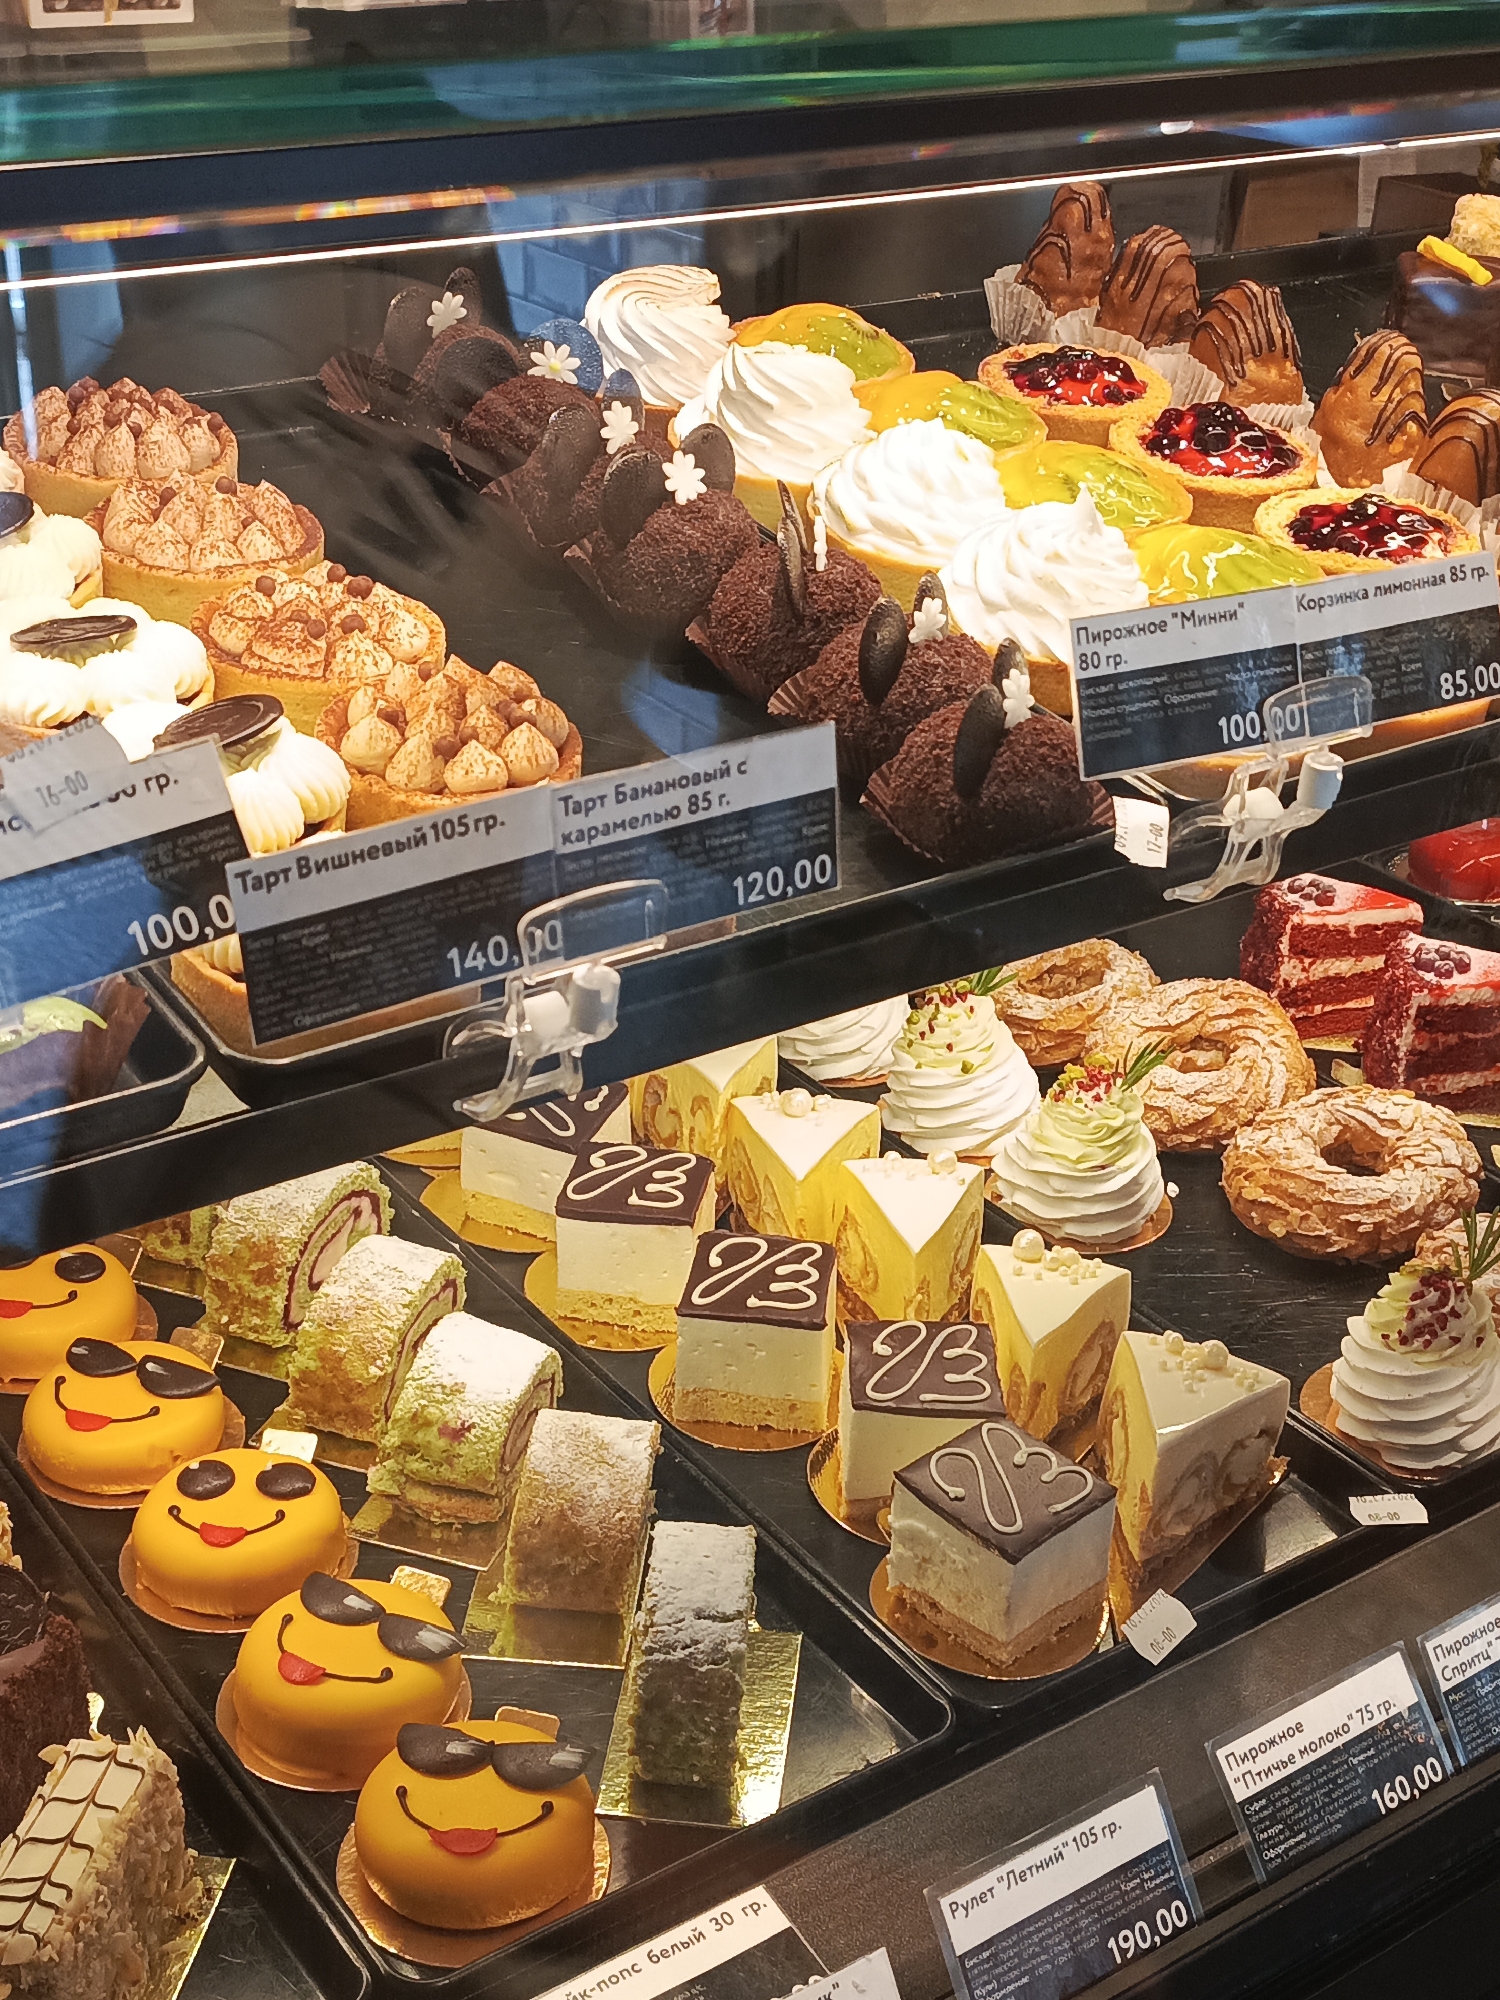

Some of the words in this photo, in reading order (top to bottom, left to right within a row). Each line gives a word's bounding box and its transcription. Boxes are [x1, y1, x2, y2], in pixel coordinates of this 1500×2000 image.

[1296, 587, 1369, 613] Корзинка
[1373, 573, 1446, 597] лимонная
[1450, 564, 1467, 583] 85
[1471, 565, 1490, 582] гр.
[1076, 619, 1168, 646] Пирожное
[1171, 602, 1245, 629] "Минни"
[1079, 652, 1101, 672] 80
[1106, 653, 1128, 671] гр.
[1440, 662, 1500, 700] 85,00
[145, 773, 179, 795] гр.
[558, 791, 607, 817] Тарт
[615, 760, 731, 804] Банановый
[737, 759, 748, 775] с
[561, 806, 681, 846] карамелью
[688, 791, 712, 815] 85
[719, 793, 731, 807] г.
[234, 866, 292, 894] Тарт
[296, 827, 428, 879] Вишневый
[431, 814, 470, 843] 105
[473, 813, 505, 837] гр.
[733, 854, 832, 905] 120,00
[1433, 1617, 1500, 1662] Пирожное
[1441, 1641, 1492, 1682] Спритц"
[1224, 1720, 1304, 1772] Пирожное
[1234, 1755, 1297, 1790] "Птичье
[1299, 1714, 1354, 1760] молоко"
[1356, 1704, 1375, 1726] 75
[1377, 1697, 1396, 1717] гр.
[1371, 1756, 1443, 1815] 160,00
[949, 1886, 996, 1920] Рулет
[997, 1842, 1070, 1891] "Летний"
[1072, 1826, 1099, 1853] 105
[1101, 1821, 1122, 1840] гр.
[647, 1927, 706, 1965] белый
[709, 1911, 735, 1932] 30
[741, 1900, 768, 1917] гр.
[1107, 1899, 1189, 1964] 190,00
